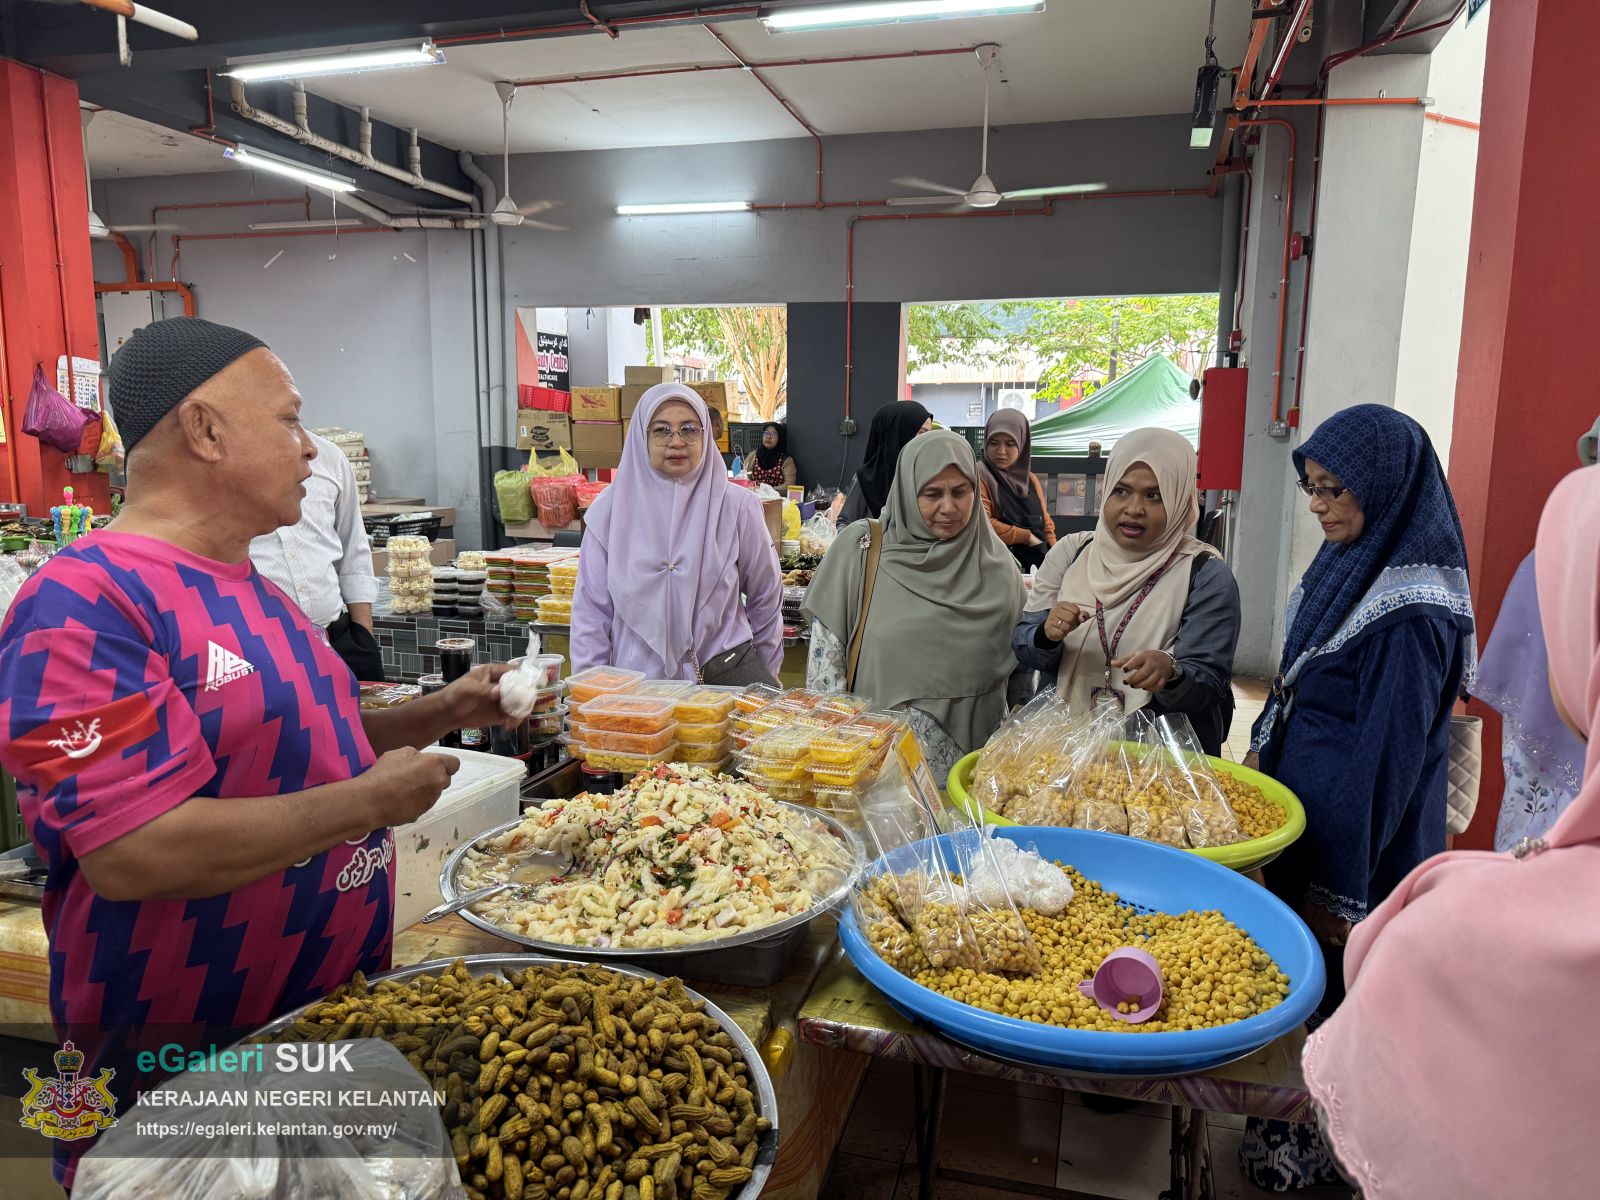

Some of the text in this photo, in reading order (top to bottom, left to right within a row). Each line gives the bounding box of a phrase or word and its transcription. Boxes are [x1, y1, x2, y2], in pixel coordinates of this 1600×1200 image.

[549, 349, 568, 373] Centre
[538, 373, 558, 382] EALTHCARE
[204, 665, 255, 692] ROBUST
